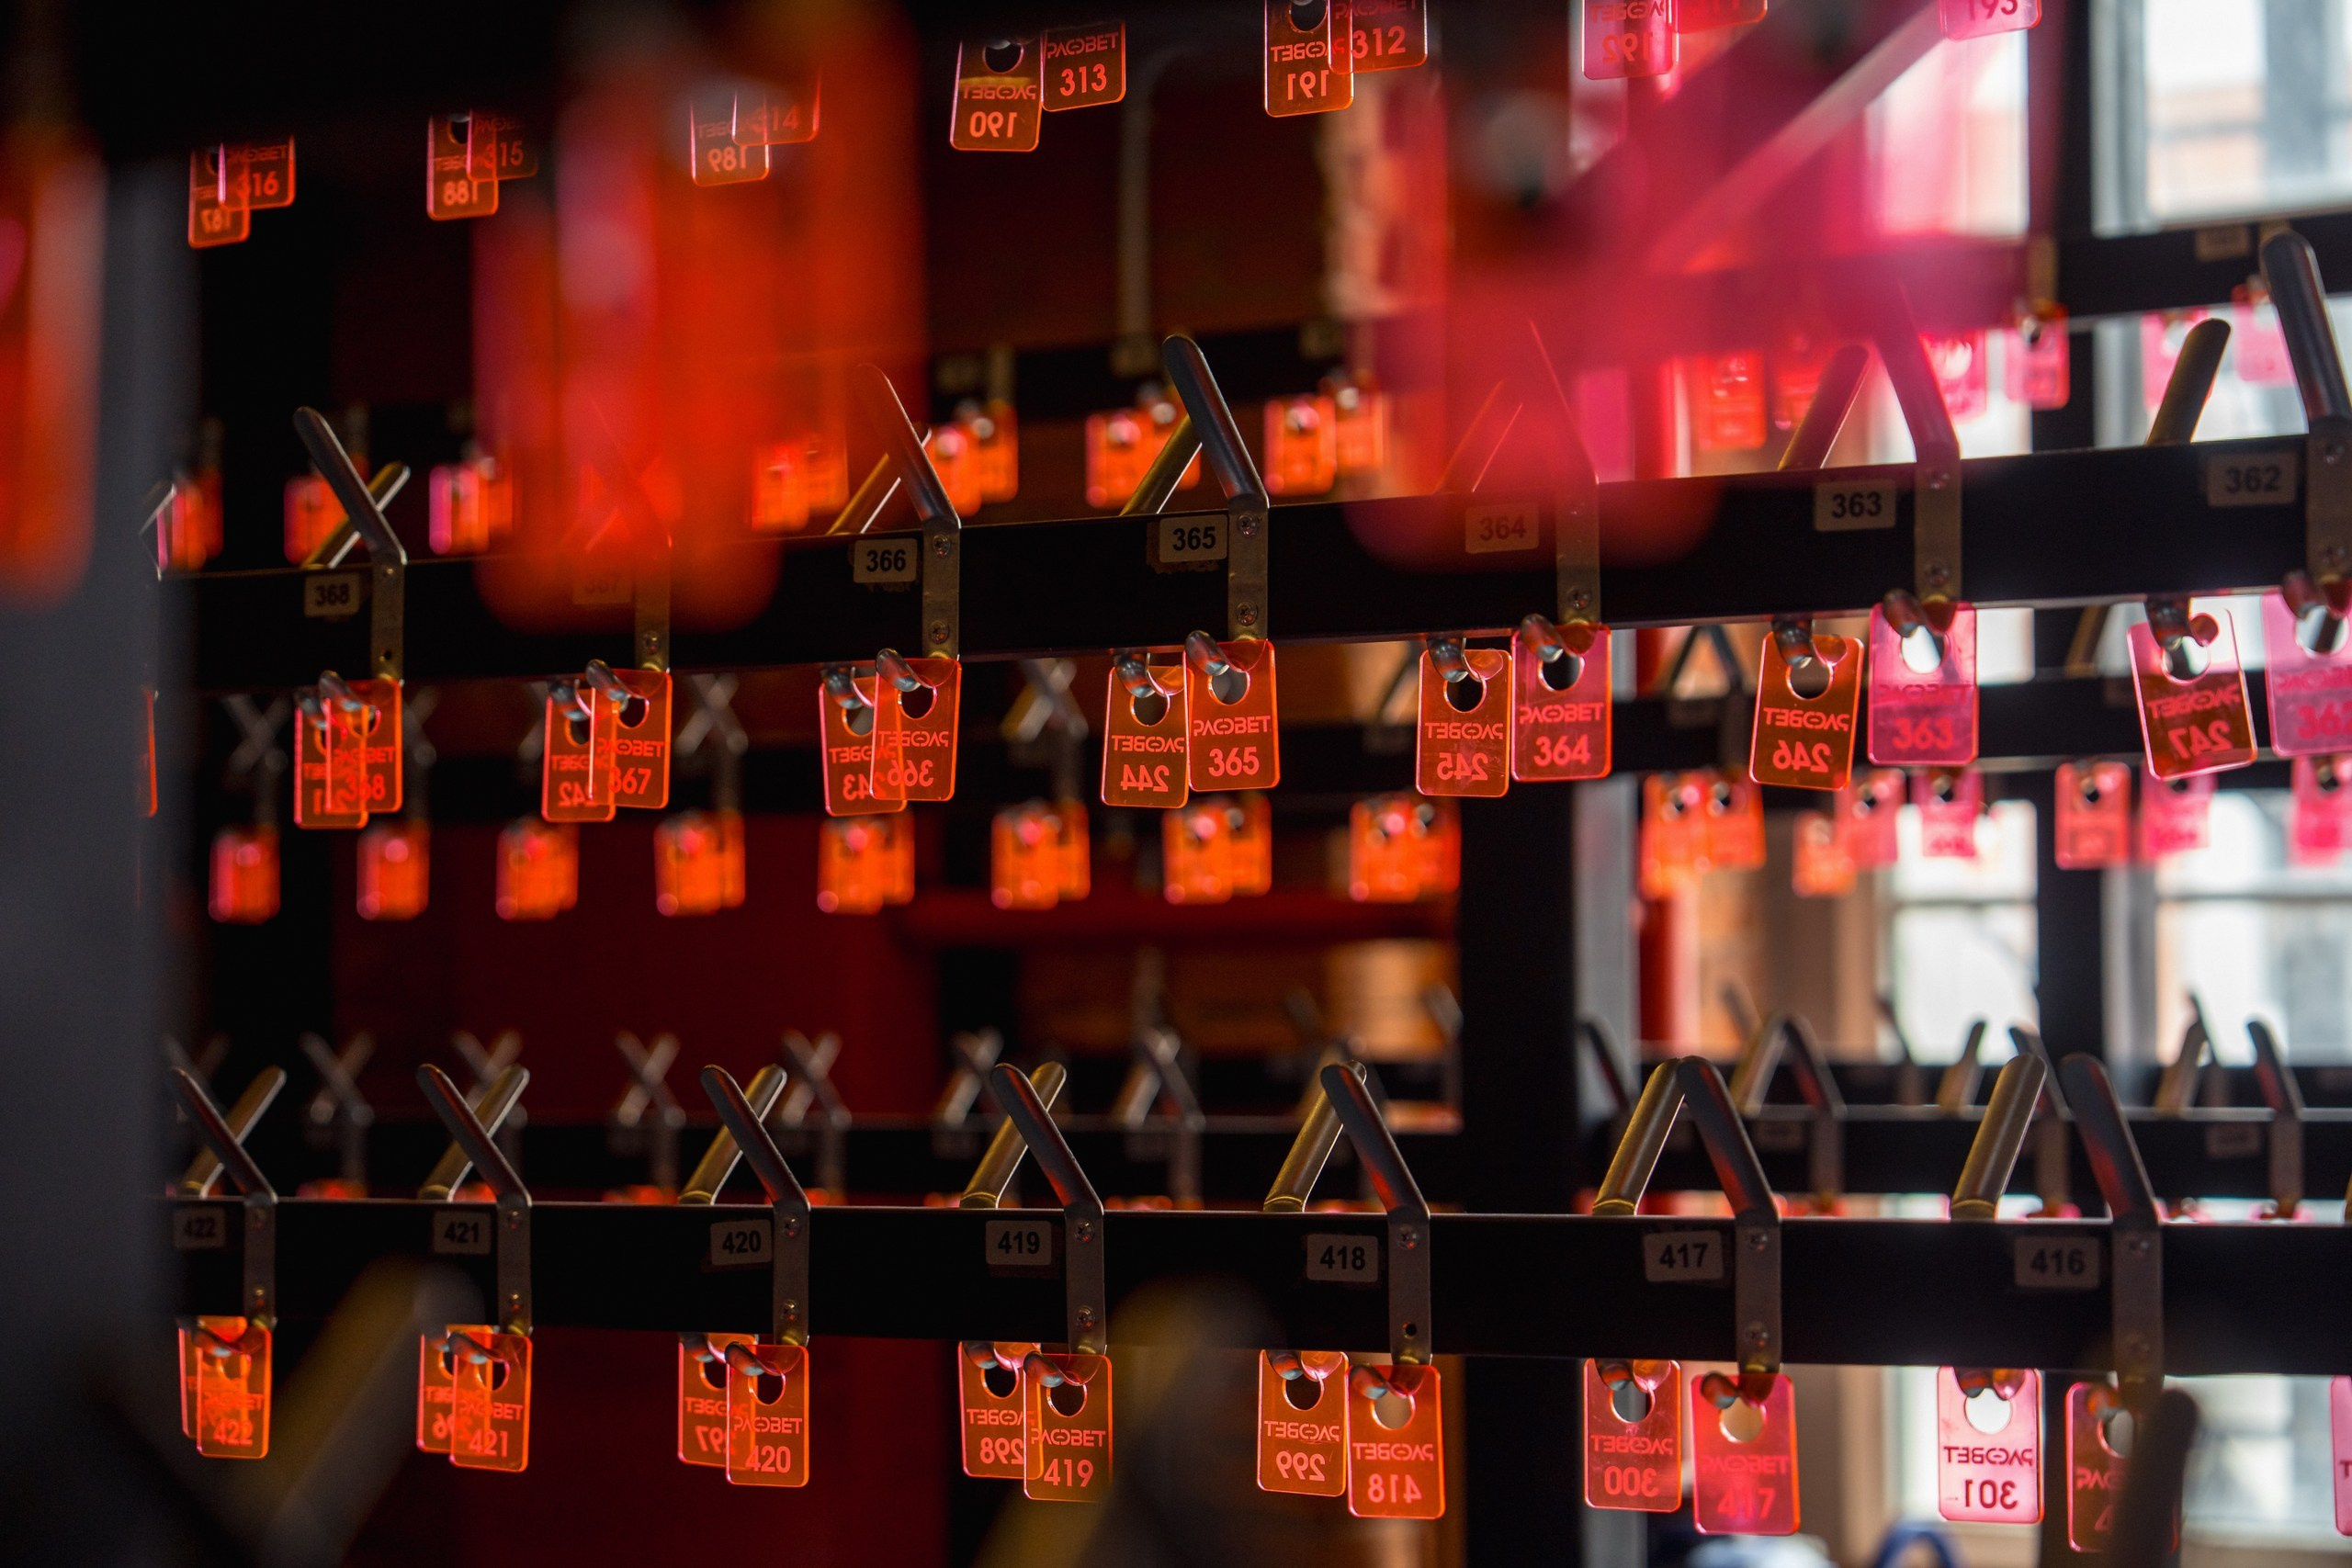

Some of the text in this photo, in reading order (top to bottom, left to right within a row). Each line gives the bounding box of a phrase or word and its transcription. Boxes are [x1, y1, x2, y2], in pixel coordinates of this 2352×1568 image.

[1352, 25, 1407, 60] 312
[1060, 63, 1107, 96] 313
[484, 140, 525, 169] 315
[2225, 464, 2282, 495] 362
[1831, 491, 1882, 519] 363
[1172, 525, 1216, 552] 365
[1479, 515, 1527, 542] 364
[865, 548, 907, 573] 366
[315, 582, 350, 607] 368
[1893, 716, 1955, 750] 363
[1208, 746, 1261, 777] 365
[1533, 733, 1592, 768] 364
[344, 773, 386, 802] 368
[608, 765, 651, 795] 367
[444, 1221, 480, 1244] 421
[722, 1230, 762, 1255] 420
[998, 1231, 1040, 1254] 419
[1320, 1245, 1365, 1271] 418
[1659, 1243, 1708, 1269] 417
[2030, 1248, 2086, 1276] 416
[212, 1418, 254, 1447] 422
[469, 1427, 510, 1459] 421
[744, 1445, 792, 1474] 420
[1044, 1459, 1094, 1488] 419
[1716, 1486, 1776, 1519] 417
